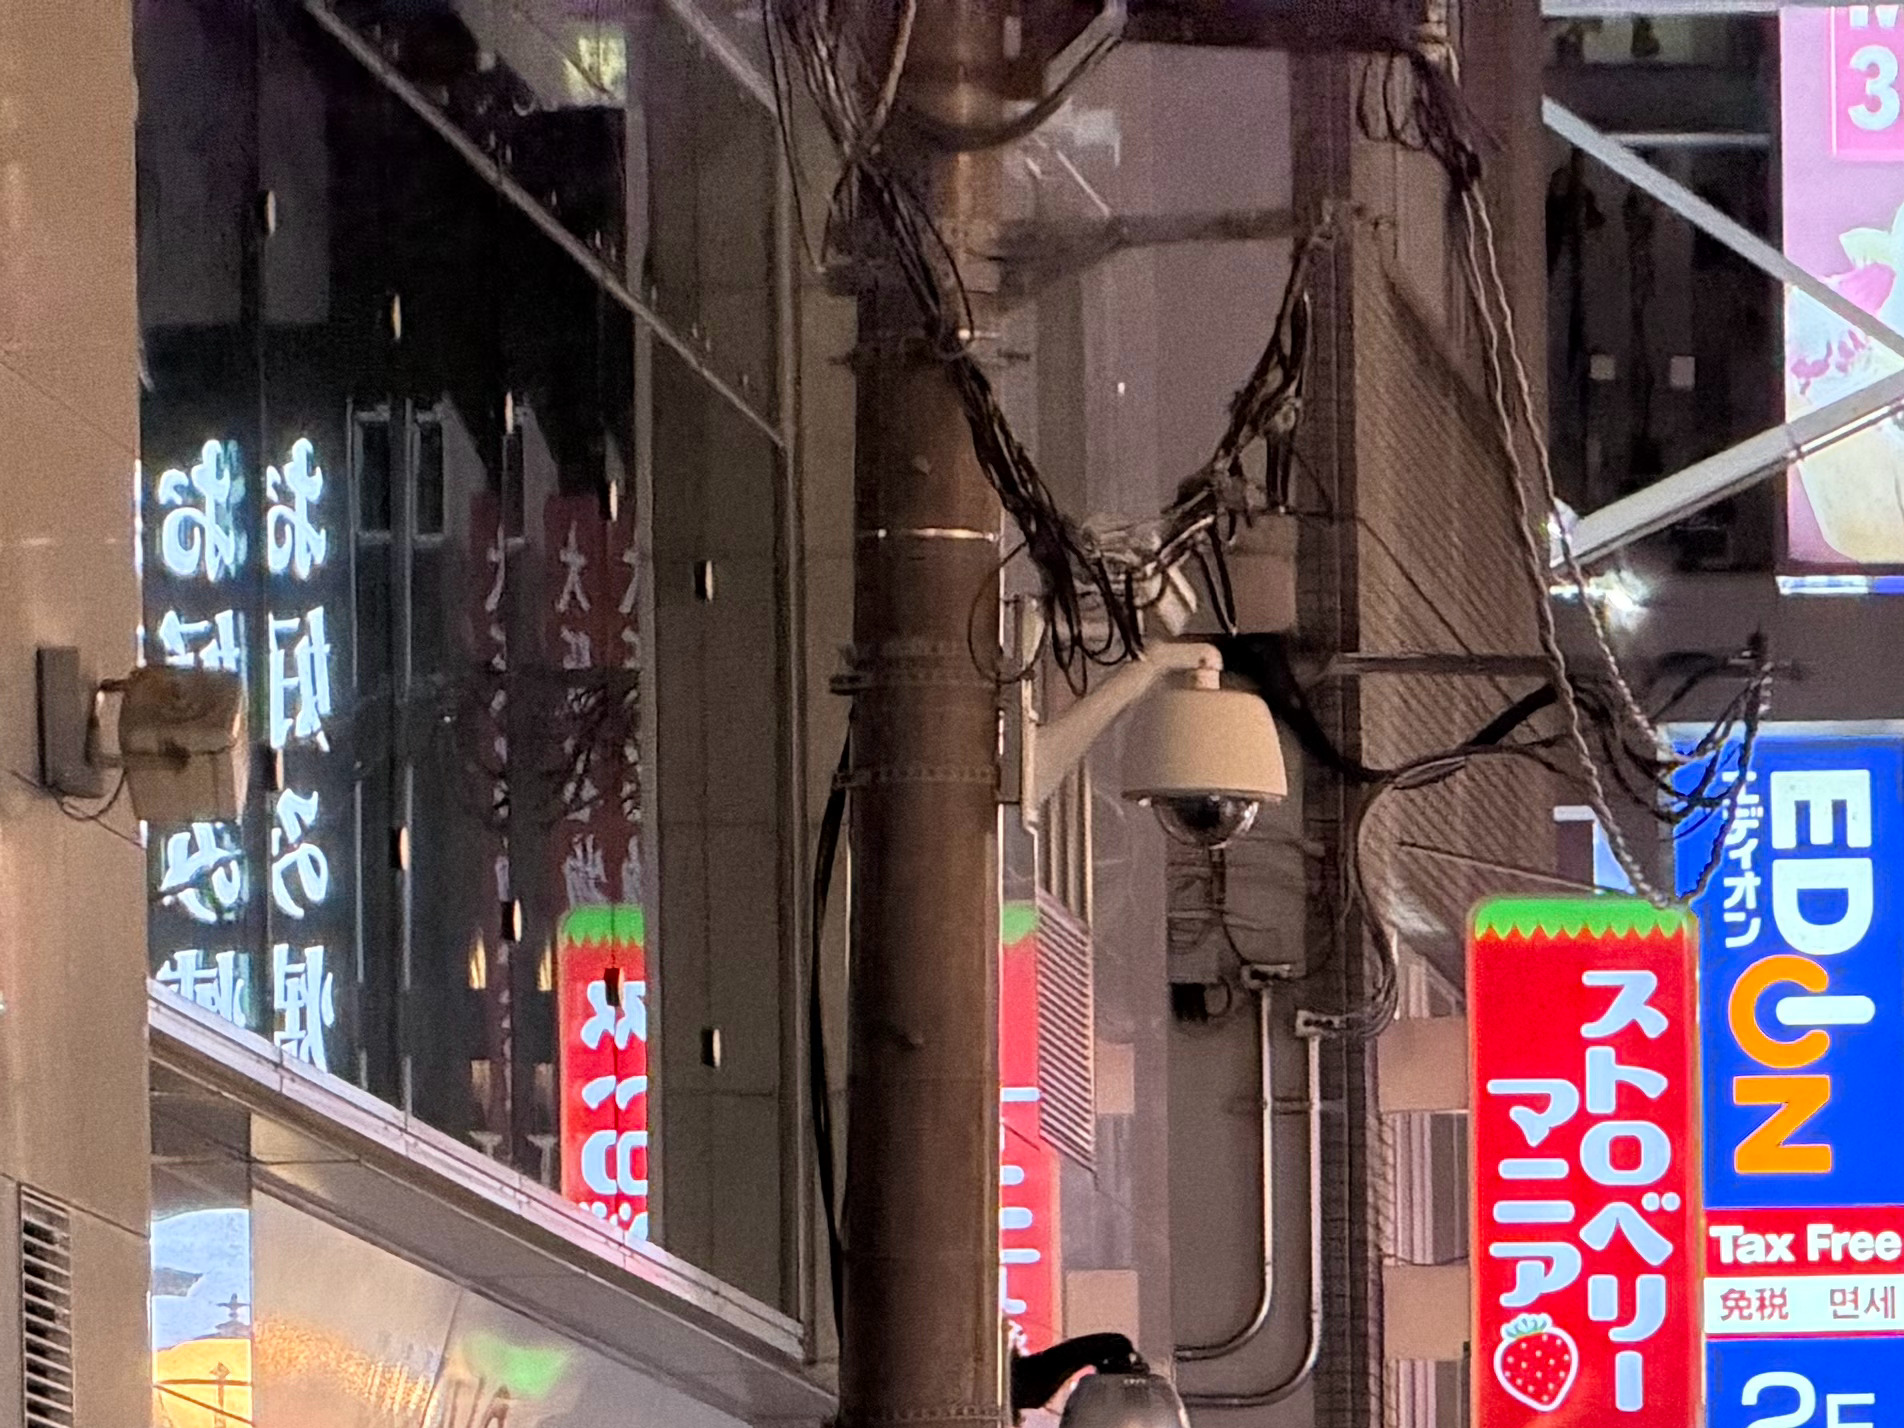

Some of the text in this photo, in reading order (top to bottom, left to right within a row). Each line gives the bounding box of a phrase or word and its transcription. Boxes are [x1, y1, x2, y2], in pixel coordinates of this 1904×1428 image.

[1486, 1077, 1583, 1309] マニア
[1580, 969, 1681, 1412] ストロベリー
[1709, 1224, 1903, 1264] Tax Free
[1719, 1287, 1898, 1322] 免税 면세
